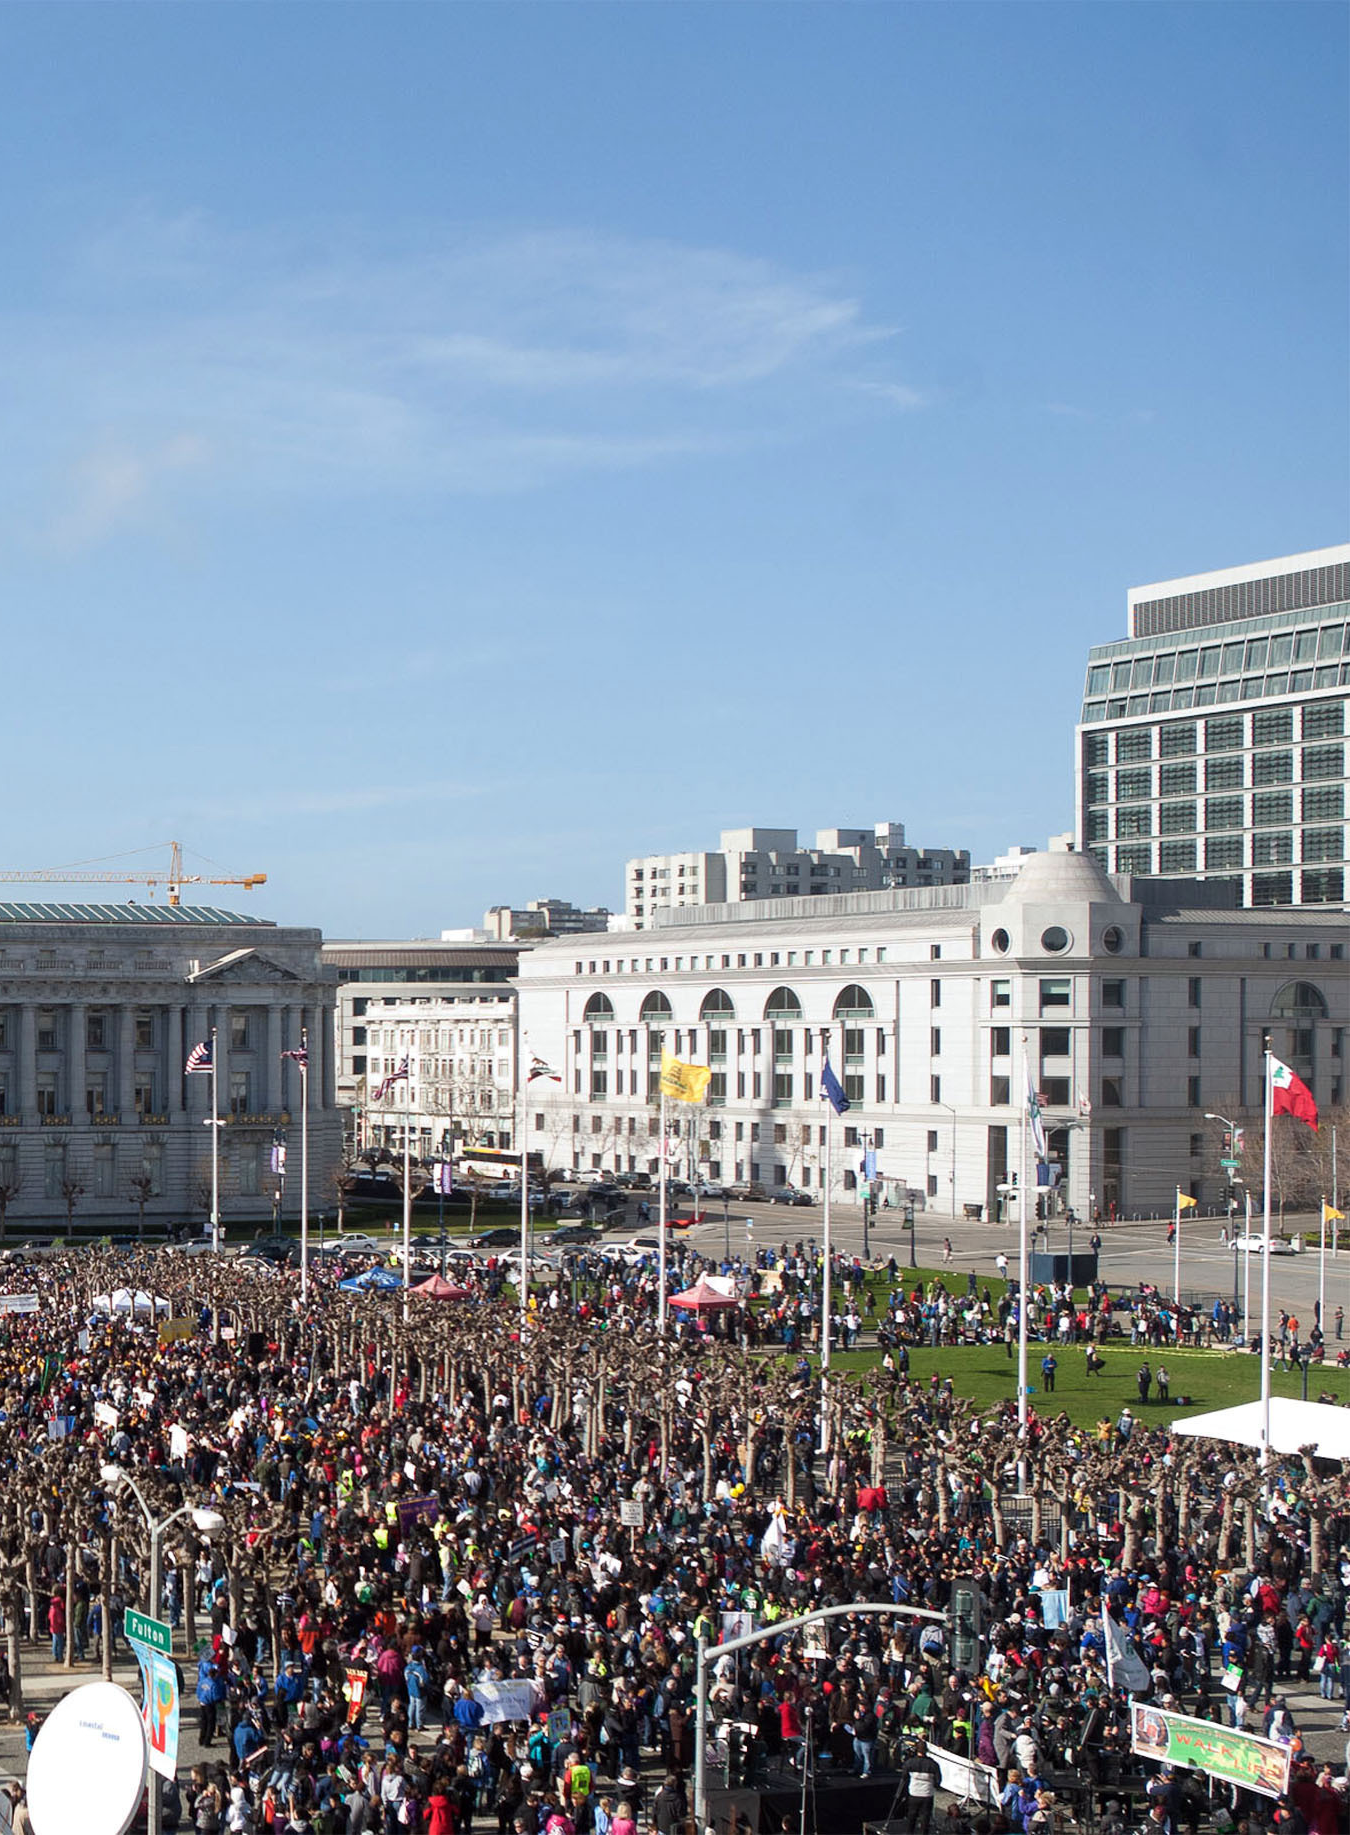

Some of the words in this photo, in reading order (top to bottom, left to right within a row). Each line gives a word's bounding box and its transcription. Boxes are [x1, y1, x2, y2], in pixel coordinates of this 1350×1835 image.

[132, 1617, 164, 1645] Fulton
[1175, 1733, 1235, 1759] WALK
[1234, 1759, 1284, 1781] LIFE
